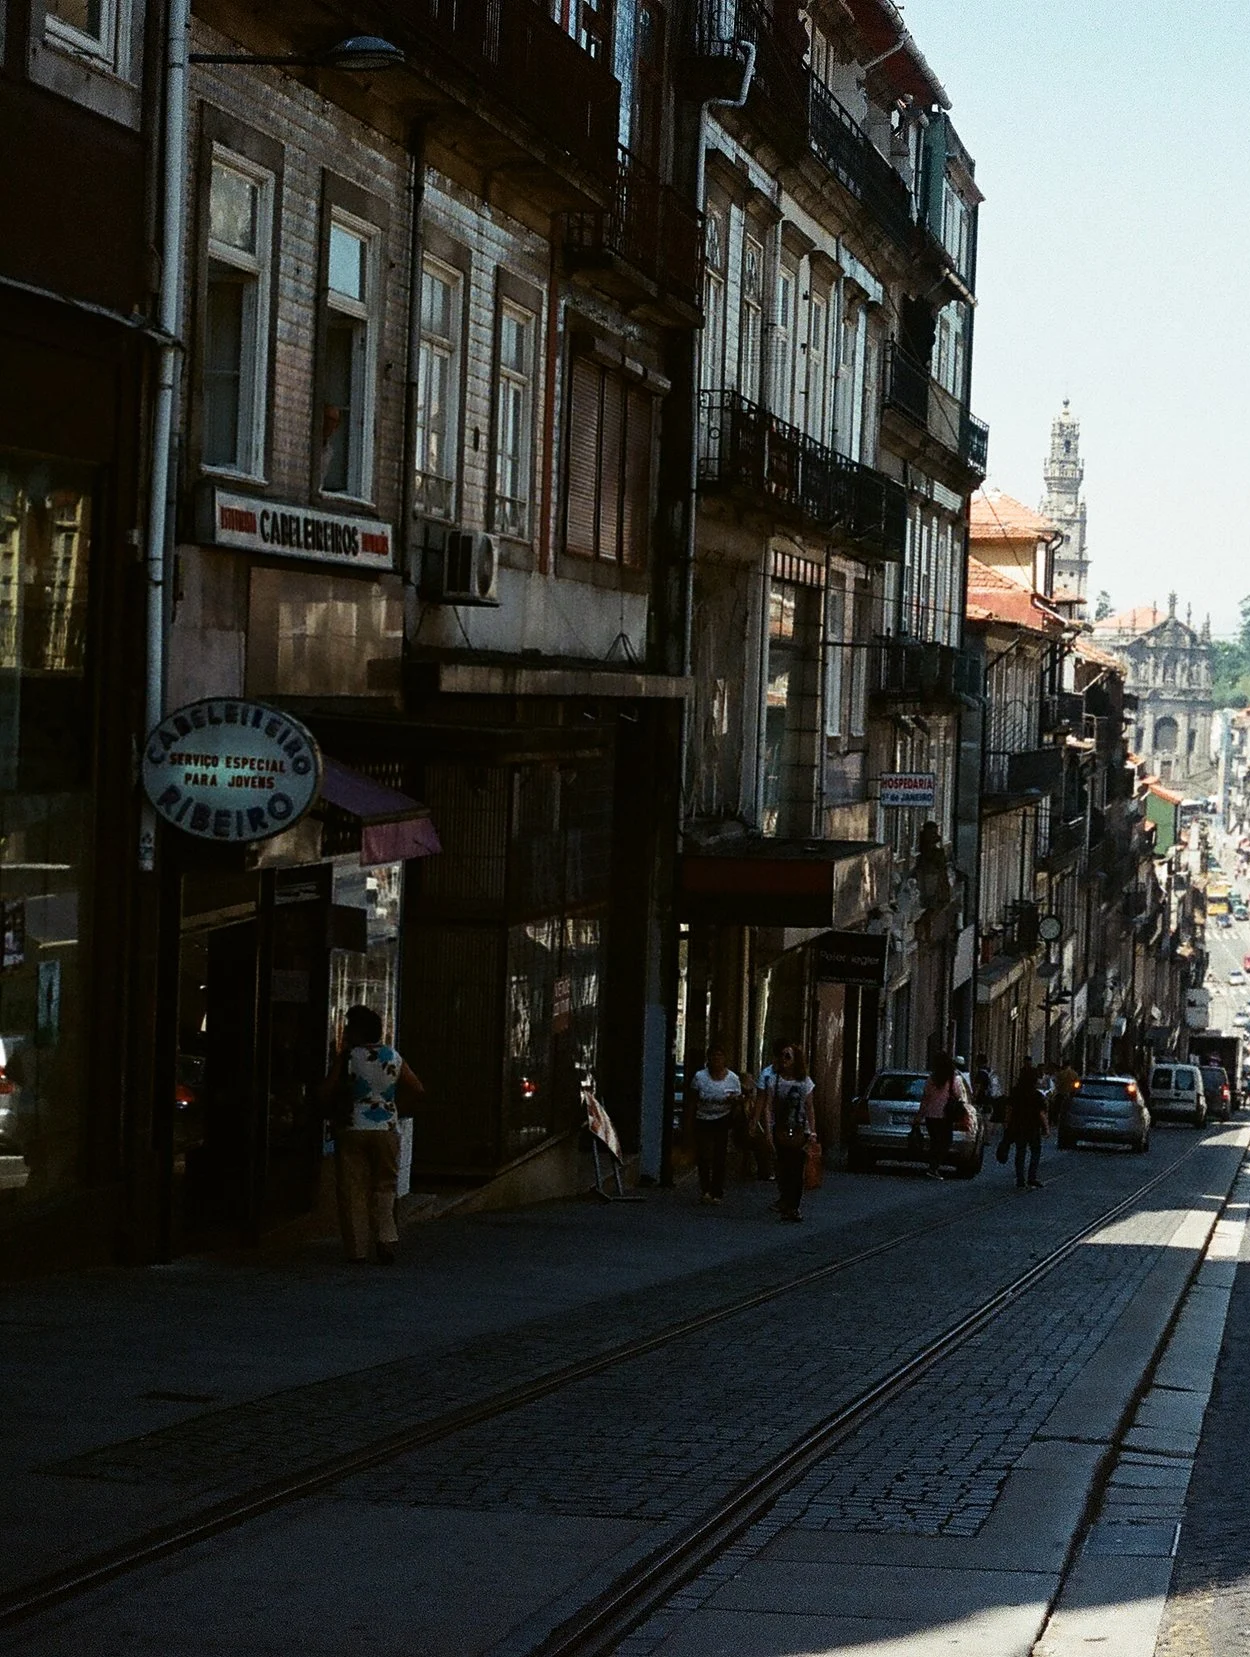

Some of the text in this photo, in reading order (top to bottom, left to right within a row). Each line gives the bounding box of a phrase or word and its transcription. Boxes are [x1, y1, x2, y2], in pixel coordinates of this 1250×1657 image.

[260, 509, 359, 556] CABELEIREIROS
[148, 703, 311, 775] CABELEIREIRO
[170, 752, 286, 773] SERVIÇO ESPECIAL
[185, 772, 275, 789] PARA JOVENS
[881, 777, 932, 789] HOSPEDARIA
[901, 793, 932, 802] JANEIRO
[157, 784, 294, 838] RIBEIRO
